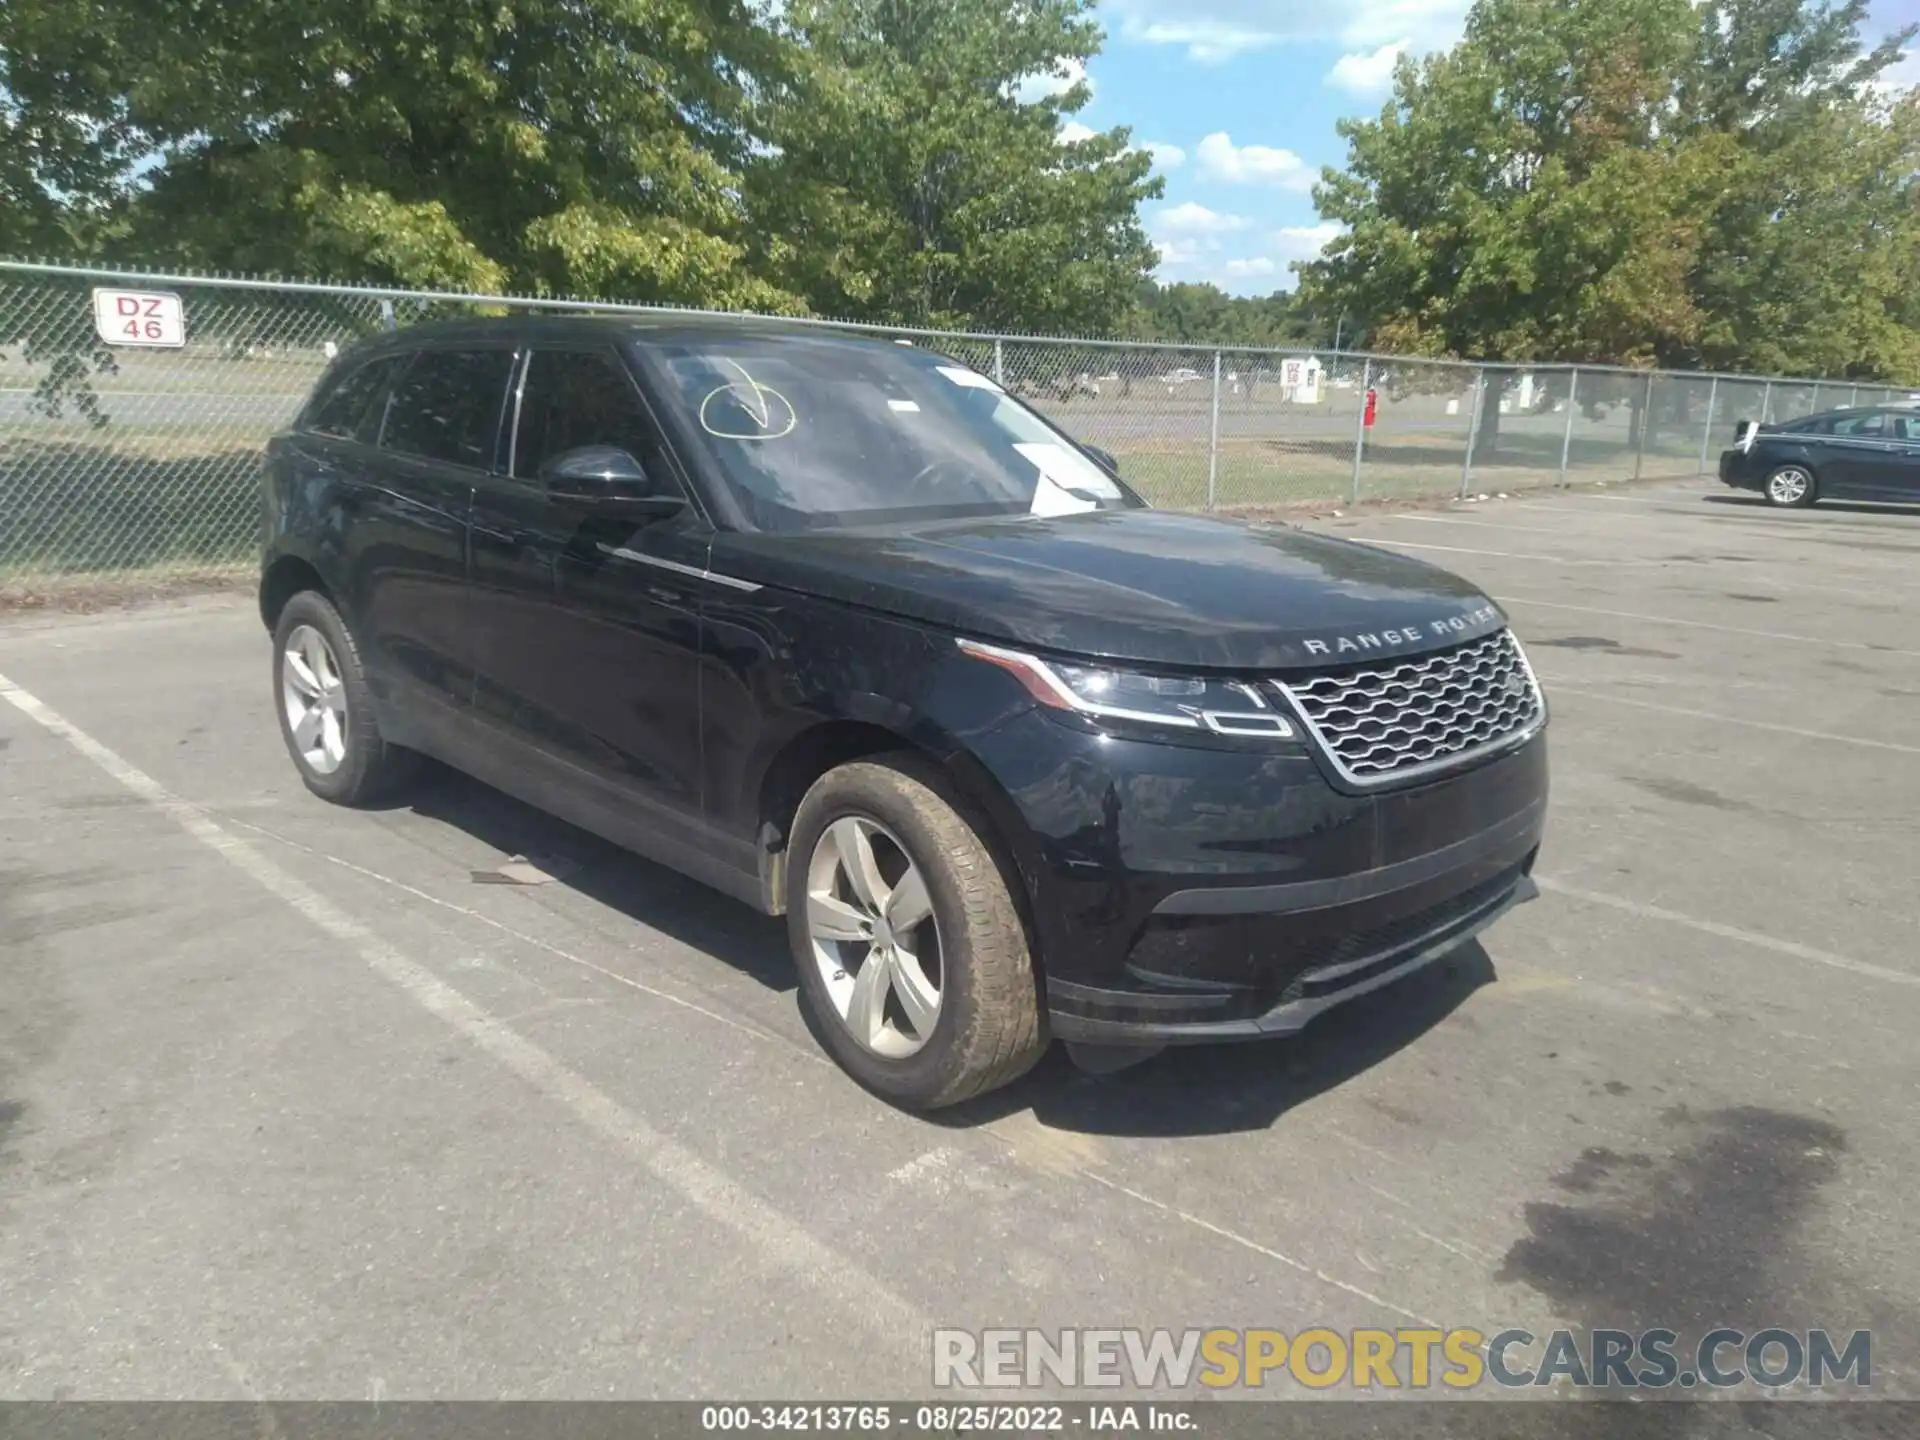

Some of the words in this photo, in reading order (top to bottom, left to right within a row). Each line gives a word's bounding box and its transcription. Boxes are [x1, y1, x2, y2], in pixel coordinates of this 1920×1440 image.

[116, 297, 163, 318] DZ
[123, 320, 163, 339] 46
[1303, 626, 1423, 655] RANGE
